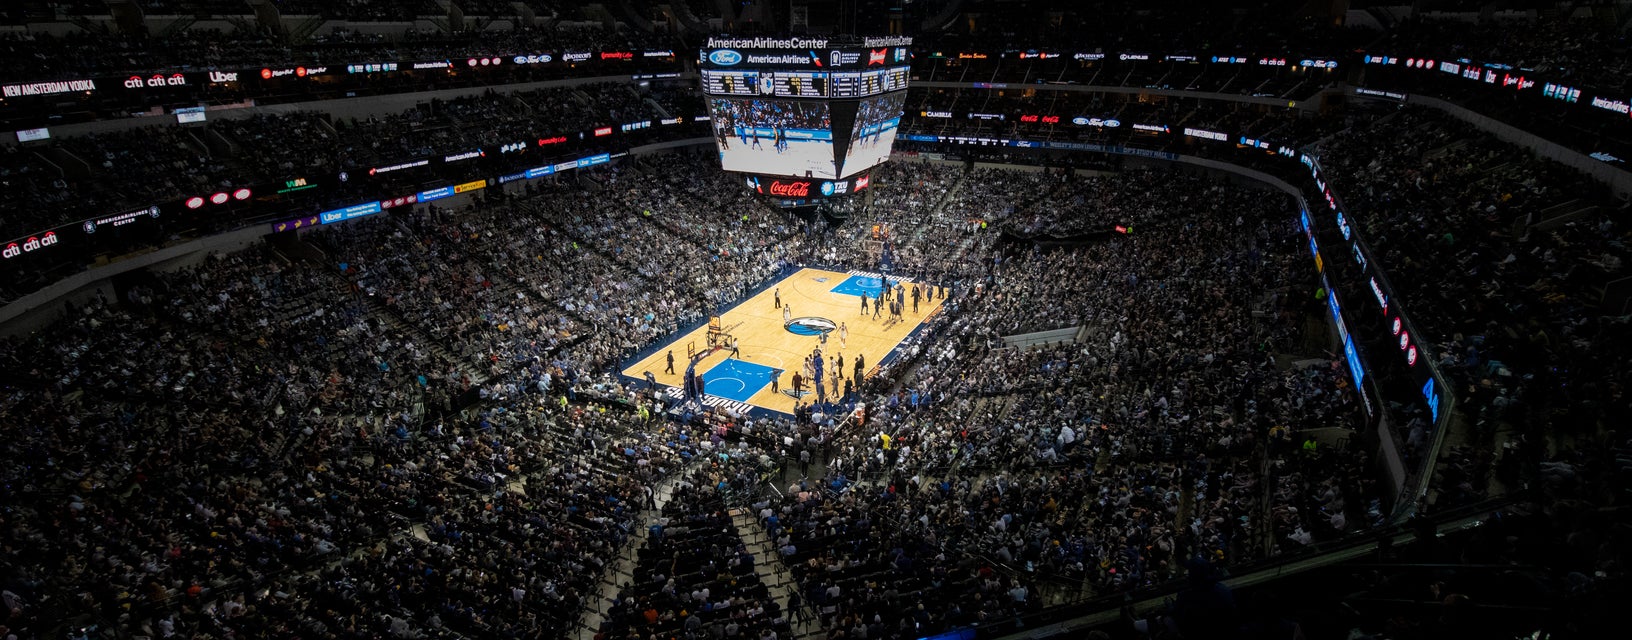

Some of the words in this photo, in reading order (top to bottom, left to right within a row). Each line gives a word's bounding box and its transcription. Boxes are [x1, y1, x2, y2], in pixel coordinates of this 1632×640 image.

[716, 53, 736, 63] Ford
[168, 76, 185, 86] citi
[209, 71, 238, 82] Uber
[125, 78, 143, 88] citi
[148, 77, 165, 87] citi
[3, 86, 22, 98] NEW
[22, 82, 69, 97] AMSTERDAM
[69, 79, 96, 92] VODKA
[286, 178, 307, 188] WM
[834, 180, 848, 189] TXU
[770, 180, 811, 197] Coca-Cola
[113, 217, 135, 227] CENTER
[323, 213, 342, 222] Uber
[23, 239, 41, 252] citi
[41, 234, 58, 247] citi
[3, 247, 21, 259] citi
